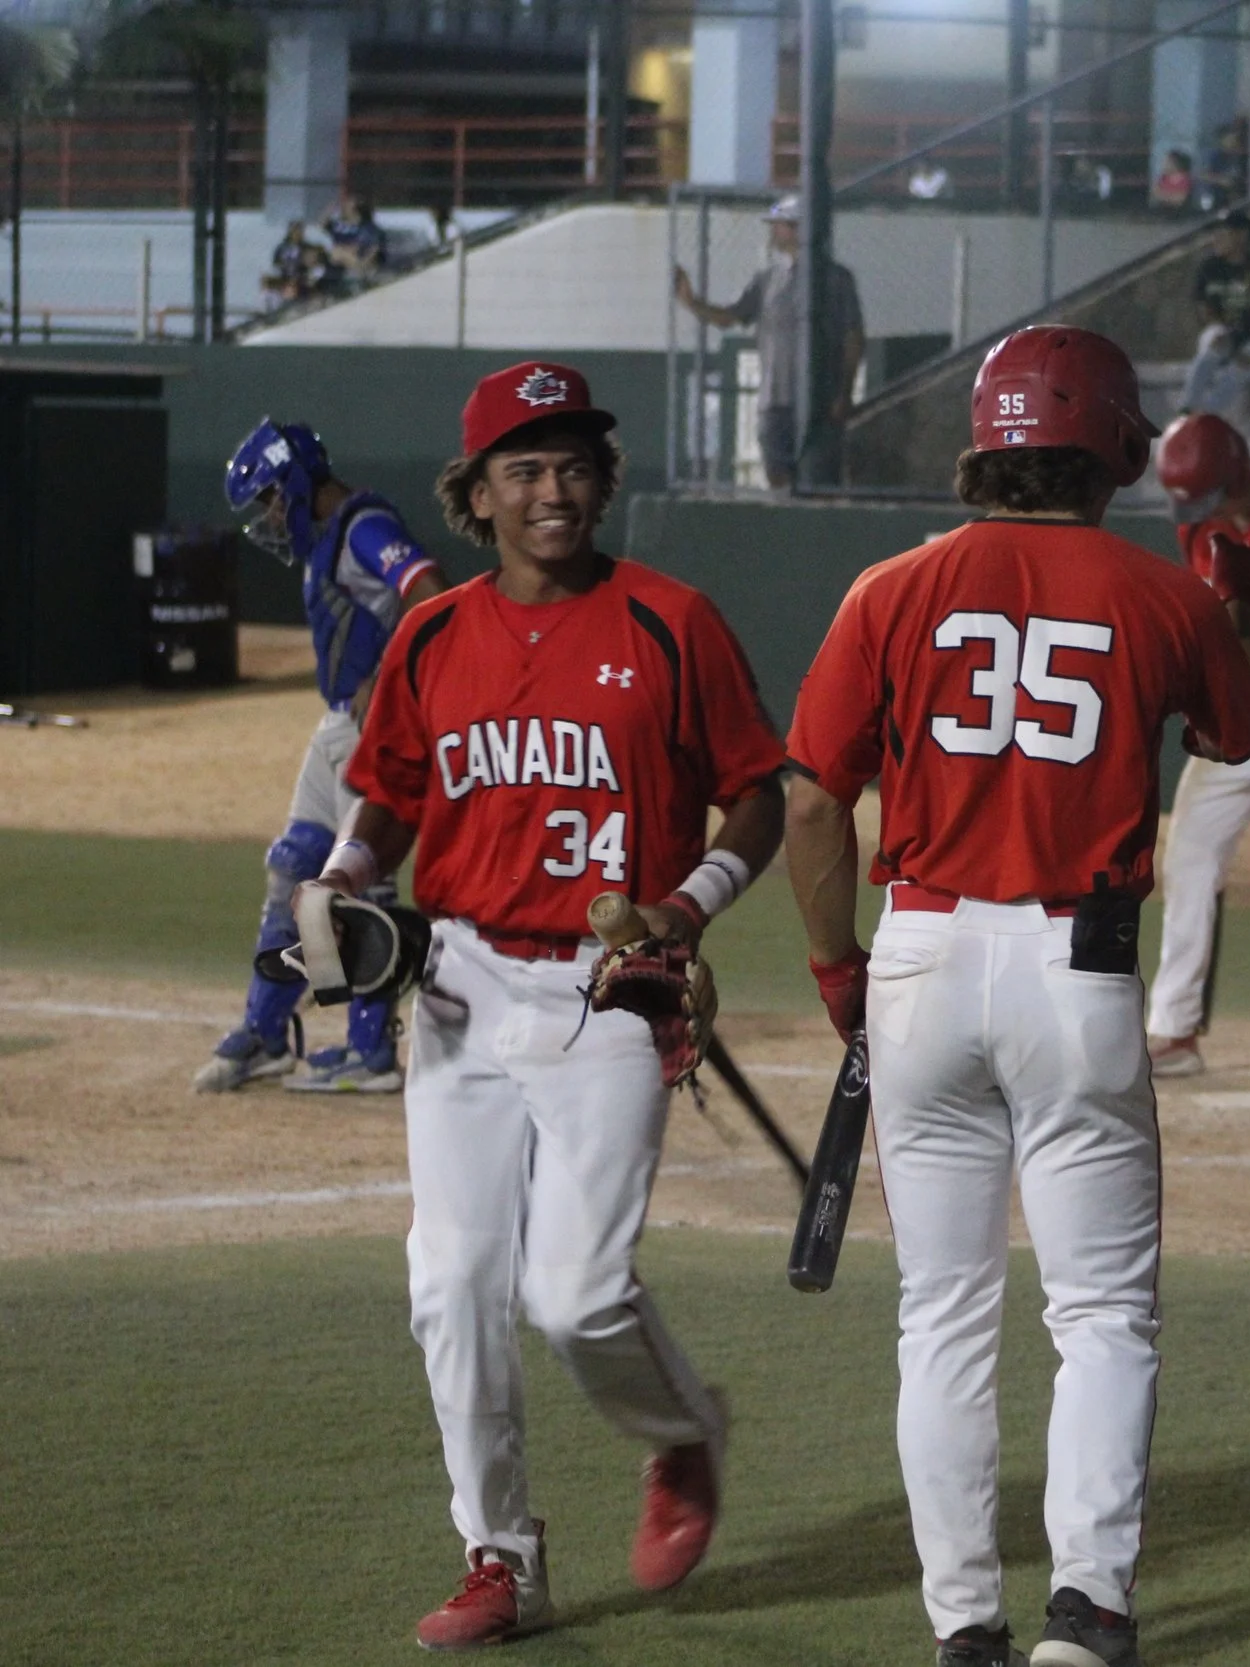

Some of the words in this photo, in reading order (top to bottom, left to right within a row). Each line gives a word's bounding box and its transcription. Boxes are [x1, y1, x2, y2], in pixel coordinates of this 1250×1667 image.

[998, 393, 1025, 415] 35
[931, 609, 1115, 767] 35
[437, 717, 622, 800] CANADA
[543, 809, 627, 882] 34
